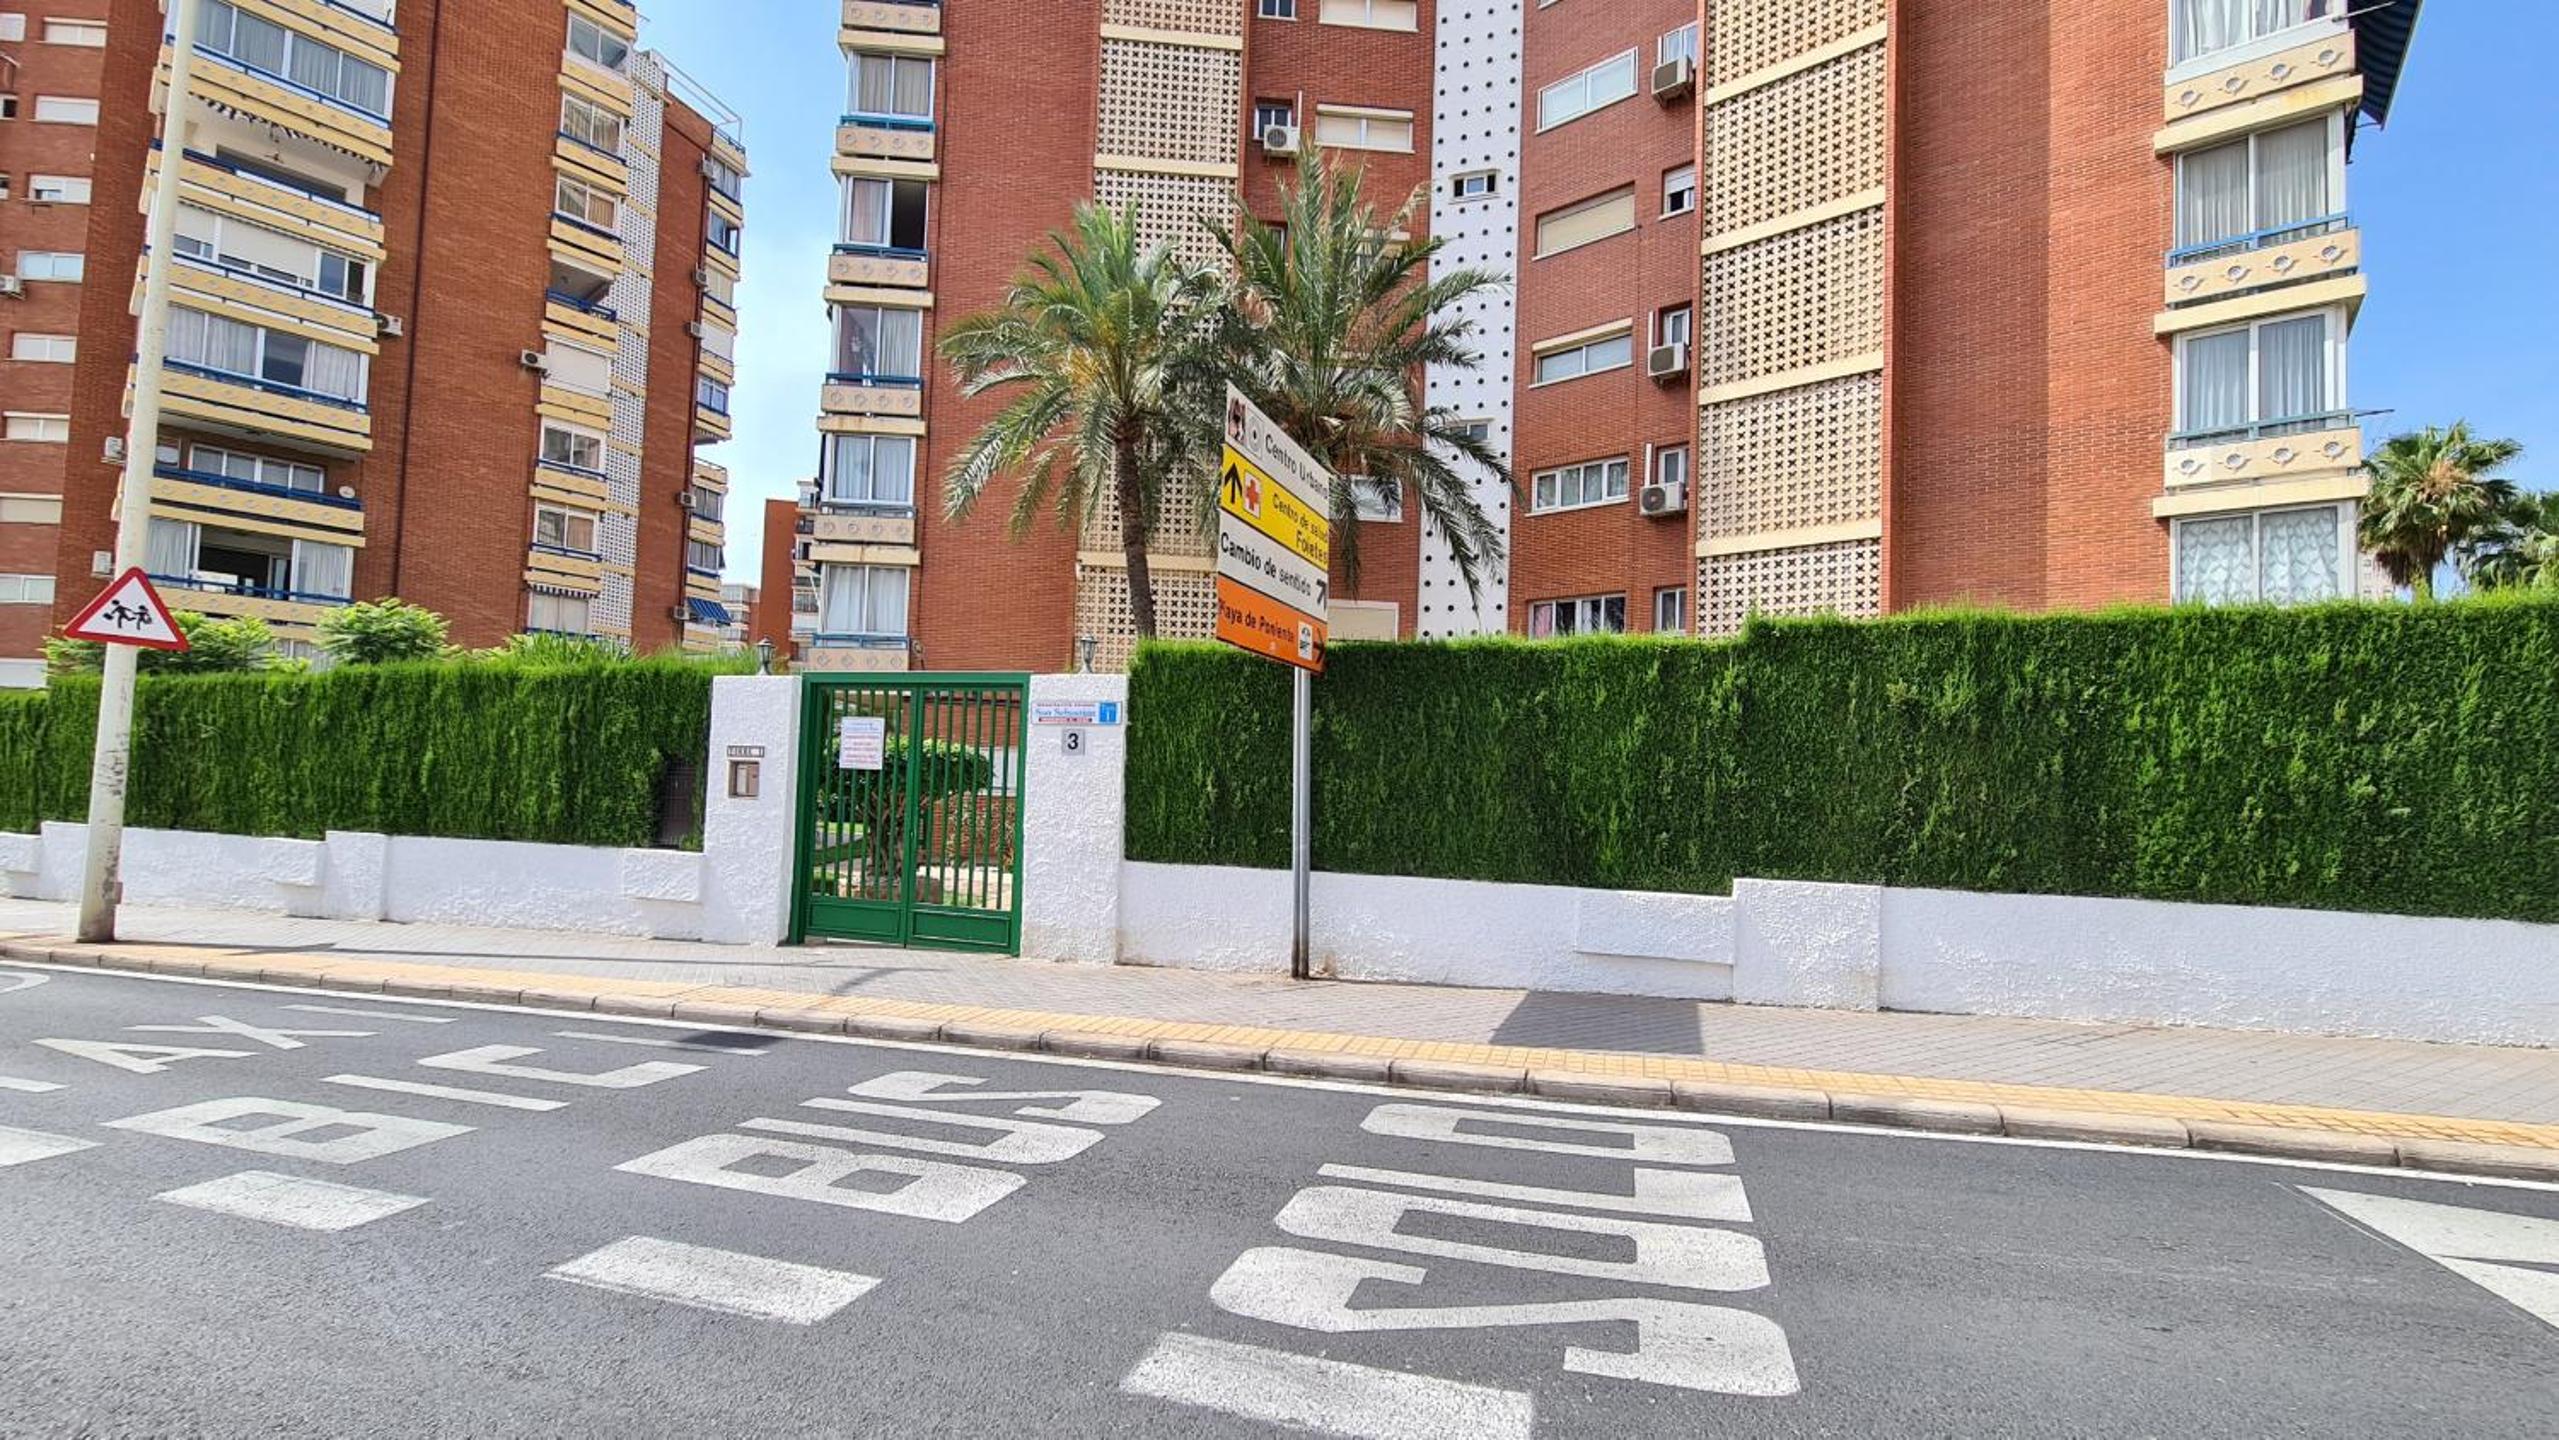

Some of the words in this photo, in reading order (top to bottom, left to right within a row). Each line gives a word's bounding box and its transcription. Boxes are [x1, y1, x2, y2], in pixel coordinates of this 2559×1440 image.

[1265, 434, 1297, 474] Centro
[1273, 493, 1298, 523] Centro
[1300, 513, 1309, 531] de
[1221, 532, 1261, 571] Cambio
[1264, 557, 1277, 578] de
[1280, 569, 1311, 596] sentido
[1245, 610, 1257, 629] de
[1260, 615, 1295, 643] Poniente
[1067, 732, 1080, 751] 3
[100, 1031, 768, 1165] BICI
[612, 1070, 1163, 1224] BUS
[1209, 1103, 1801, 1397] SOLO
